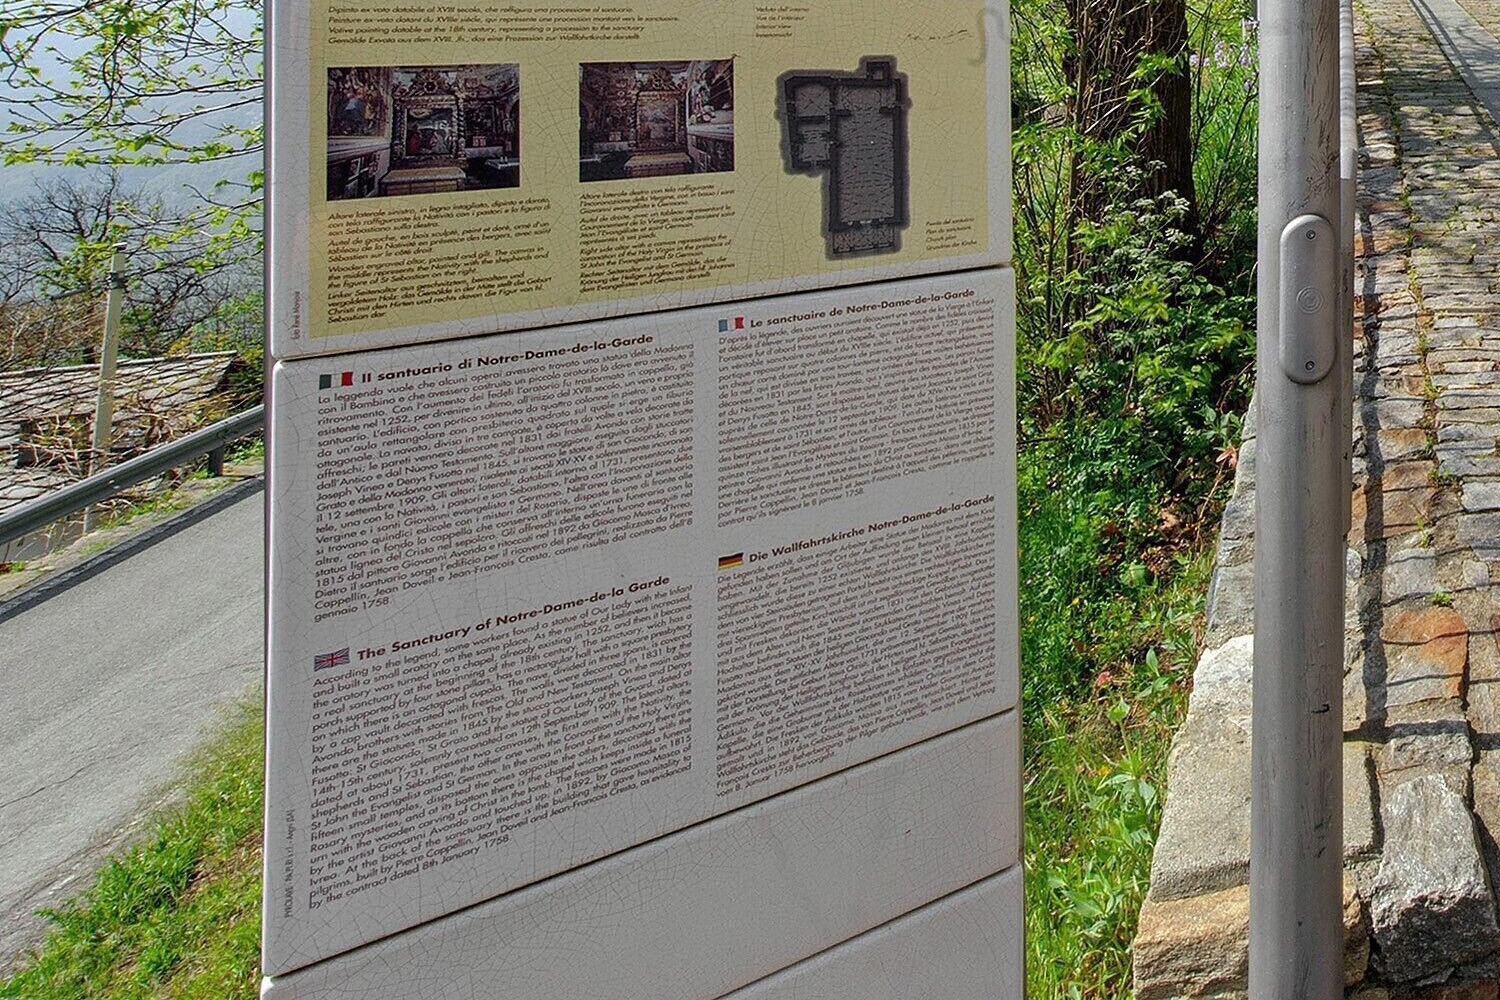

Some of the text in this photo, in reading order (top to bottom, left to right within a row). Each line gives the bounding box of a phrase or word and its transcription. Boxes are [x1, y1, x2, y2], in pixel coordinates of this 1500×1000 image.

[750, 289, 974, 328] Le sanctuaire de Notre-Dame-de-la-Garde
[317, 394, 331, 403] La
[333, 387, 384, 402] leggenda
[417, 379, 436, 389] che
[437, 375, 468, 386] alcuni
[470, 370, 502, 382] operai
[504, 365, 546, 376] avessero
[548, 359, 580, 369] trovato
[601, 353, 628, 362] statua
[628, 348, 652, 358] della
[653, 344, 694, 354] Madonna
[361, 334, 653, 383] Il santuario di Notre-Dame-de-la-Garde
[748, 494, 994, 563] Die Wallfahrtskirche Notre-Dame-de-la-Garde
[312, 668, 369, 688] According
[371, 664, 382, 673] to
[384, 658, 402, 669] the
[444, 642, 470, 654] some
[471, 632, 510, 647] workers
[512, 621, 540, 636] found
[551, 614, 577, 626] statue
[579, 609, 589, 619] of
[590, 606, 609, 616] Our
[611, 599, 632, 611] Lady
[634, 593, 652, 605] with
[653, 590, 667, 600] the
[669, 584, 692, 596] Infant
[313, 596, 389, 623] gennaio 1758.
[357, 576, 669, 661] The Sanctuary of Notre-Dame-de-la Garde
[312, 684, 335, 699] and
[336, 679, 360, 692] built
[373, 667, 400, 683] small
[401, 660, 440, 675] oratory
[441, 656, 456, 665] on
[457, 650, 473, 661] the
[475, 644, 500, 656] same
[533, 631, 545, 641] As
[547, 627, 562, 637] the
[563, 619, 598, 633] number
[599, 613, 609, 623] of
[610, 606, 648, 621] believers
[310, 790, 343, 809] dated
[346, 787, 358, 798] at
[361, 777, 393, 794] about
[432, 754, 469, 774] present
[472, 749, 491, 760] two
[543, 728, 558, 738] the
[561, 721, 579, 733] first
[581, 716, 599, 727] one
[601, 707, 621, 721] with
[623, 704, 637, 714] the
[678, 687, 692, 697] the
[310, 826, 344, 842] fifteen
[348, 813, 376, 830] small
[426, 783, 471, 805] disposed
[474, 779, 492, 790] the
[492, 772, 515, 785] ones
[518, 759, 558, 777] opposite
[561, 752, 576, 763] the
[611, 725, 656, 747] decorated
[658, 719, 676, 732] with
[678, 716, 692, 726] the
[308, 833, 509, 909] by the contract dated 8th January 1758.
